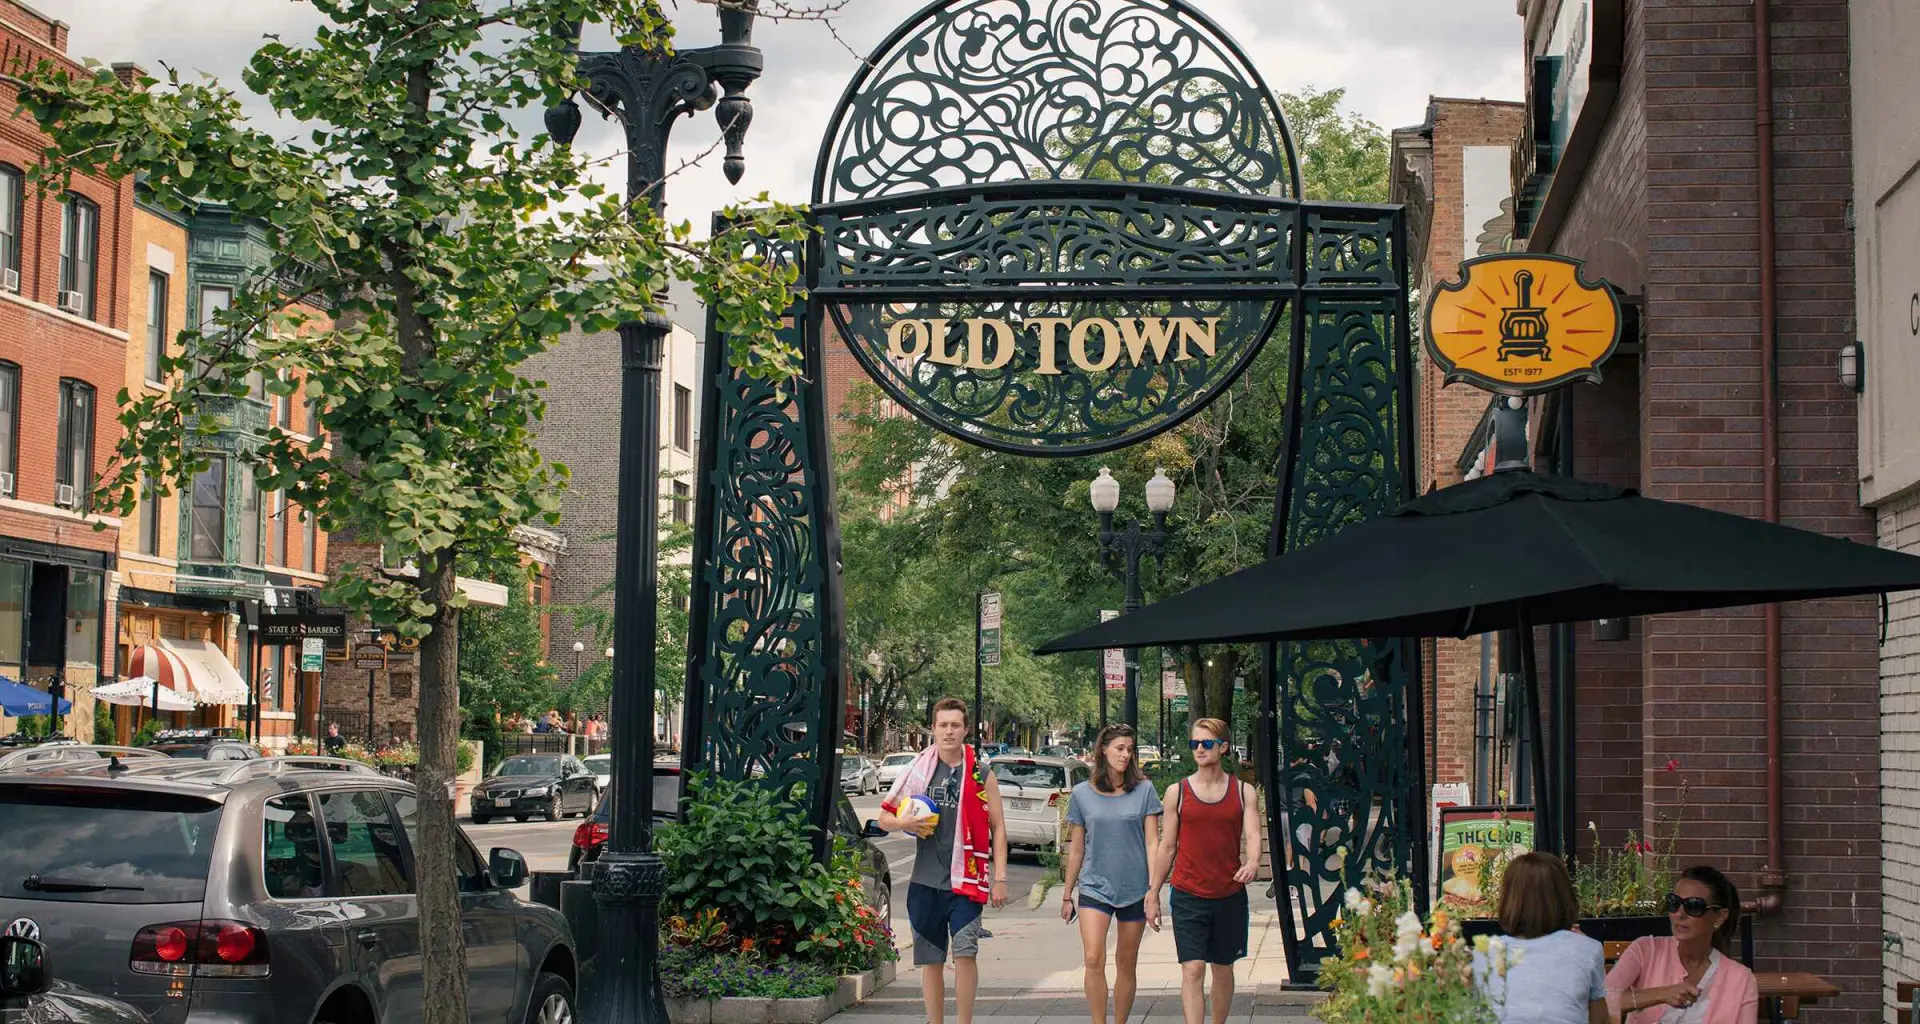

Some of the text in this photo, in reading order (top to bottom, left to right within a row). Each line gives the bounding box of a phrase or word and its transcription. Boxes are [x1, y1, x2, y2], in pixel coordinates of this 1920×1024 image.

[888, 317, 1221, 375] OLD TOWN
[1525, 368, 1542, 376] 1977
[269, 626, 288, 634] STATE
[291, 626, 298, 634] ST
[1457, 830, 1485, 844] THE
